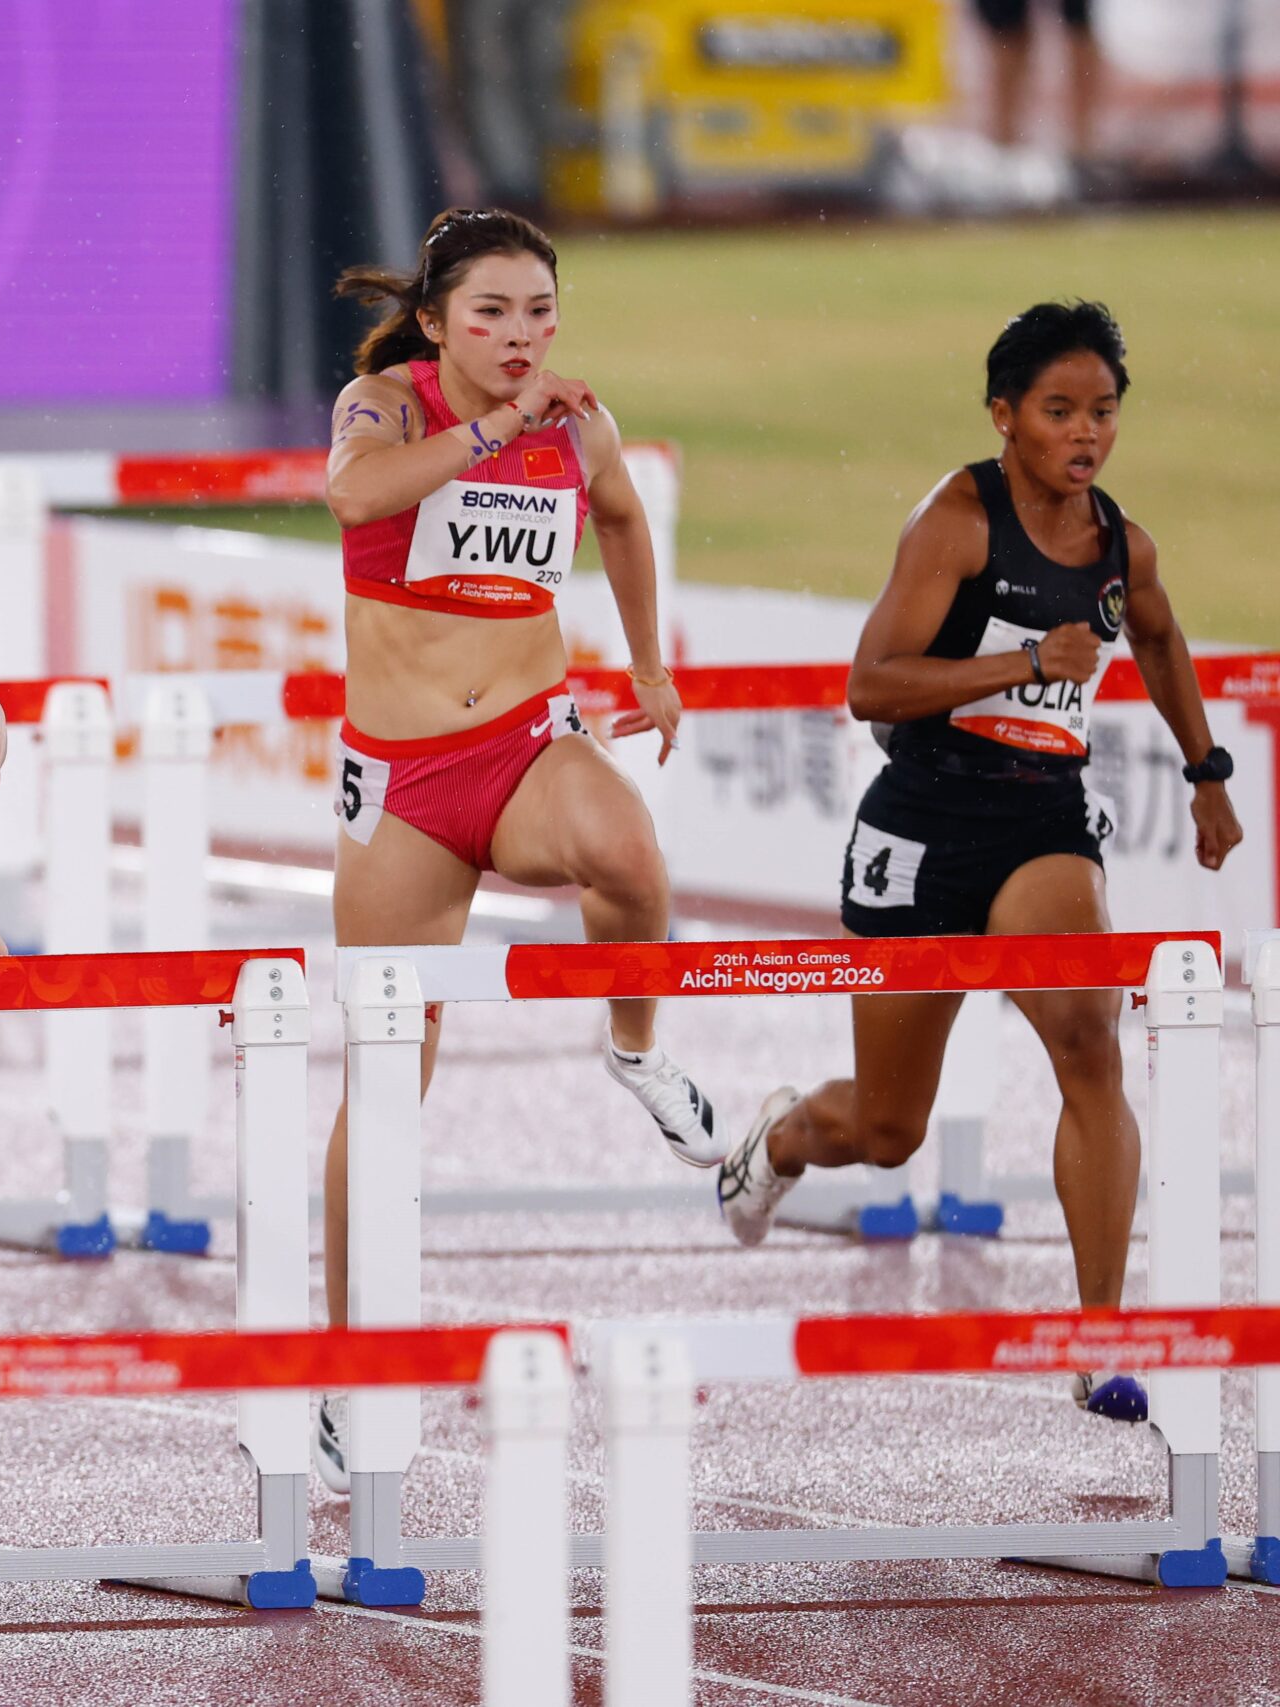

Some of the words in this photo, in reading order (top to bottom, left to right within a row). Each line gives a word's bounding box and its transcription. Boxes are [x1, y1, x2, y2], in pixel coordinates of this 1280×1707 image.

[461, 491, 557, 514] BORNAN
[460, 508, 493, 520] SPORTS
[497, 511, 552, 524] TECHNOLOGY
[447, 522, 556, 567] Y.WU
[535, 570, 562, 584] 270
[461, 588, 512, 601] Aichi-Nagoya
[513, 592, 532, 600] 2026
[342, 757, 362, 822] 5
[864, 846, 892, 897] 4
[713, 953, 748, 967] 20th
[752, 952, 793, 965] Asian
[797, 952, 851, 965] Games
[680, 968, 825, 991] Aichi-Nagoya
[831, 967, 884, 986] 2026
